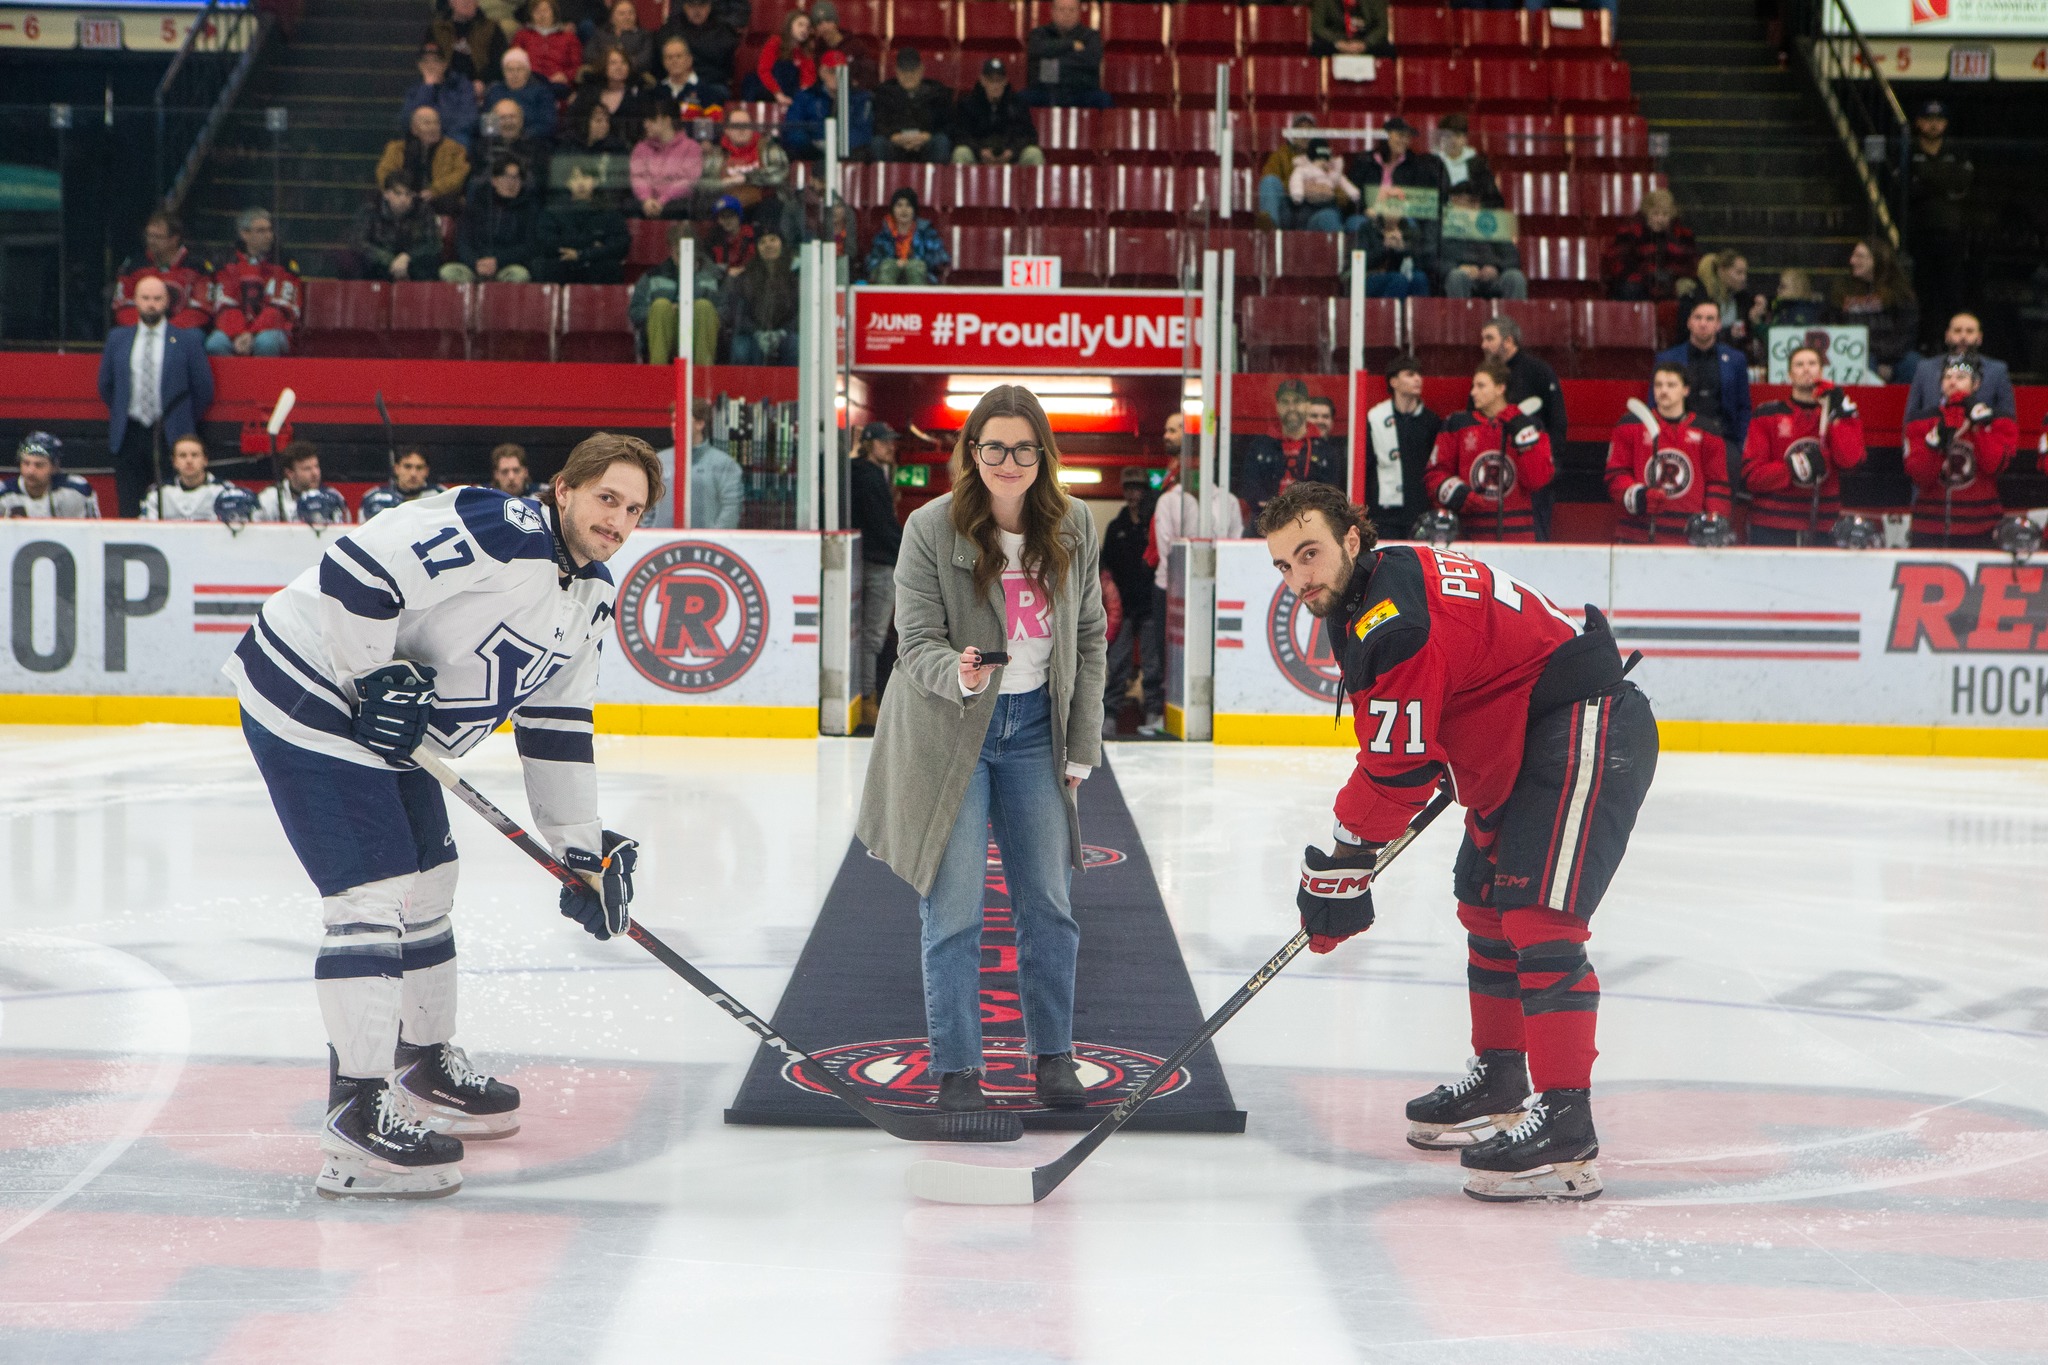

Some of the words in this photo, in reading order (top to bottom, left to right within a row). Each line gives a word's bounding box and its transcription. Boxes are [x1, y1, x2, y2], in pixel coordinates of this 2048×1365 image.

[23, 14, 41, 40] 6
[160, 17, 177, 42] 5
[1896, 46, 1911, 72] 5
[1010, 259, 1054, 287] EXIT
[882, 313, 922, 331] UNB
[411, 526, 475, 580] 17
[12, 540, 171, 673] OP
[624, 562, 658, 653] UNIVERSITY
[664, 549, 682, 565] OF
[693, 549, 725, 566] NEW
[730, 566, 761, 655] BRUNSWICK
[1885, 561, 2048, 655] RE
[668, 670, 715, 685] REDS
[1368, 699, 1426, 755] 71
[568, 852, 592, 862] CCM
[1494, 873, 1530, 888] CM
[707, 992, 807, 1064] CCM
[431, 1089, 467, 1106] BAUER
[366, 1132, 403, 1152] BAUER
